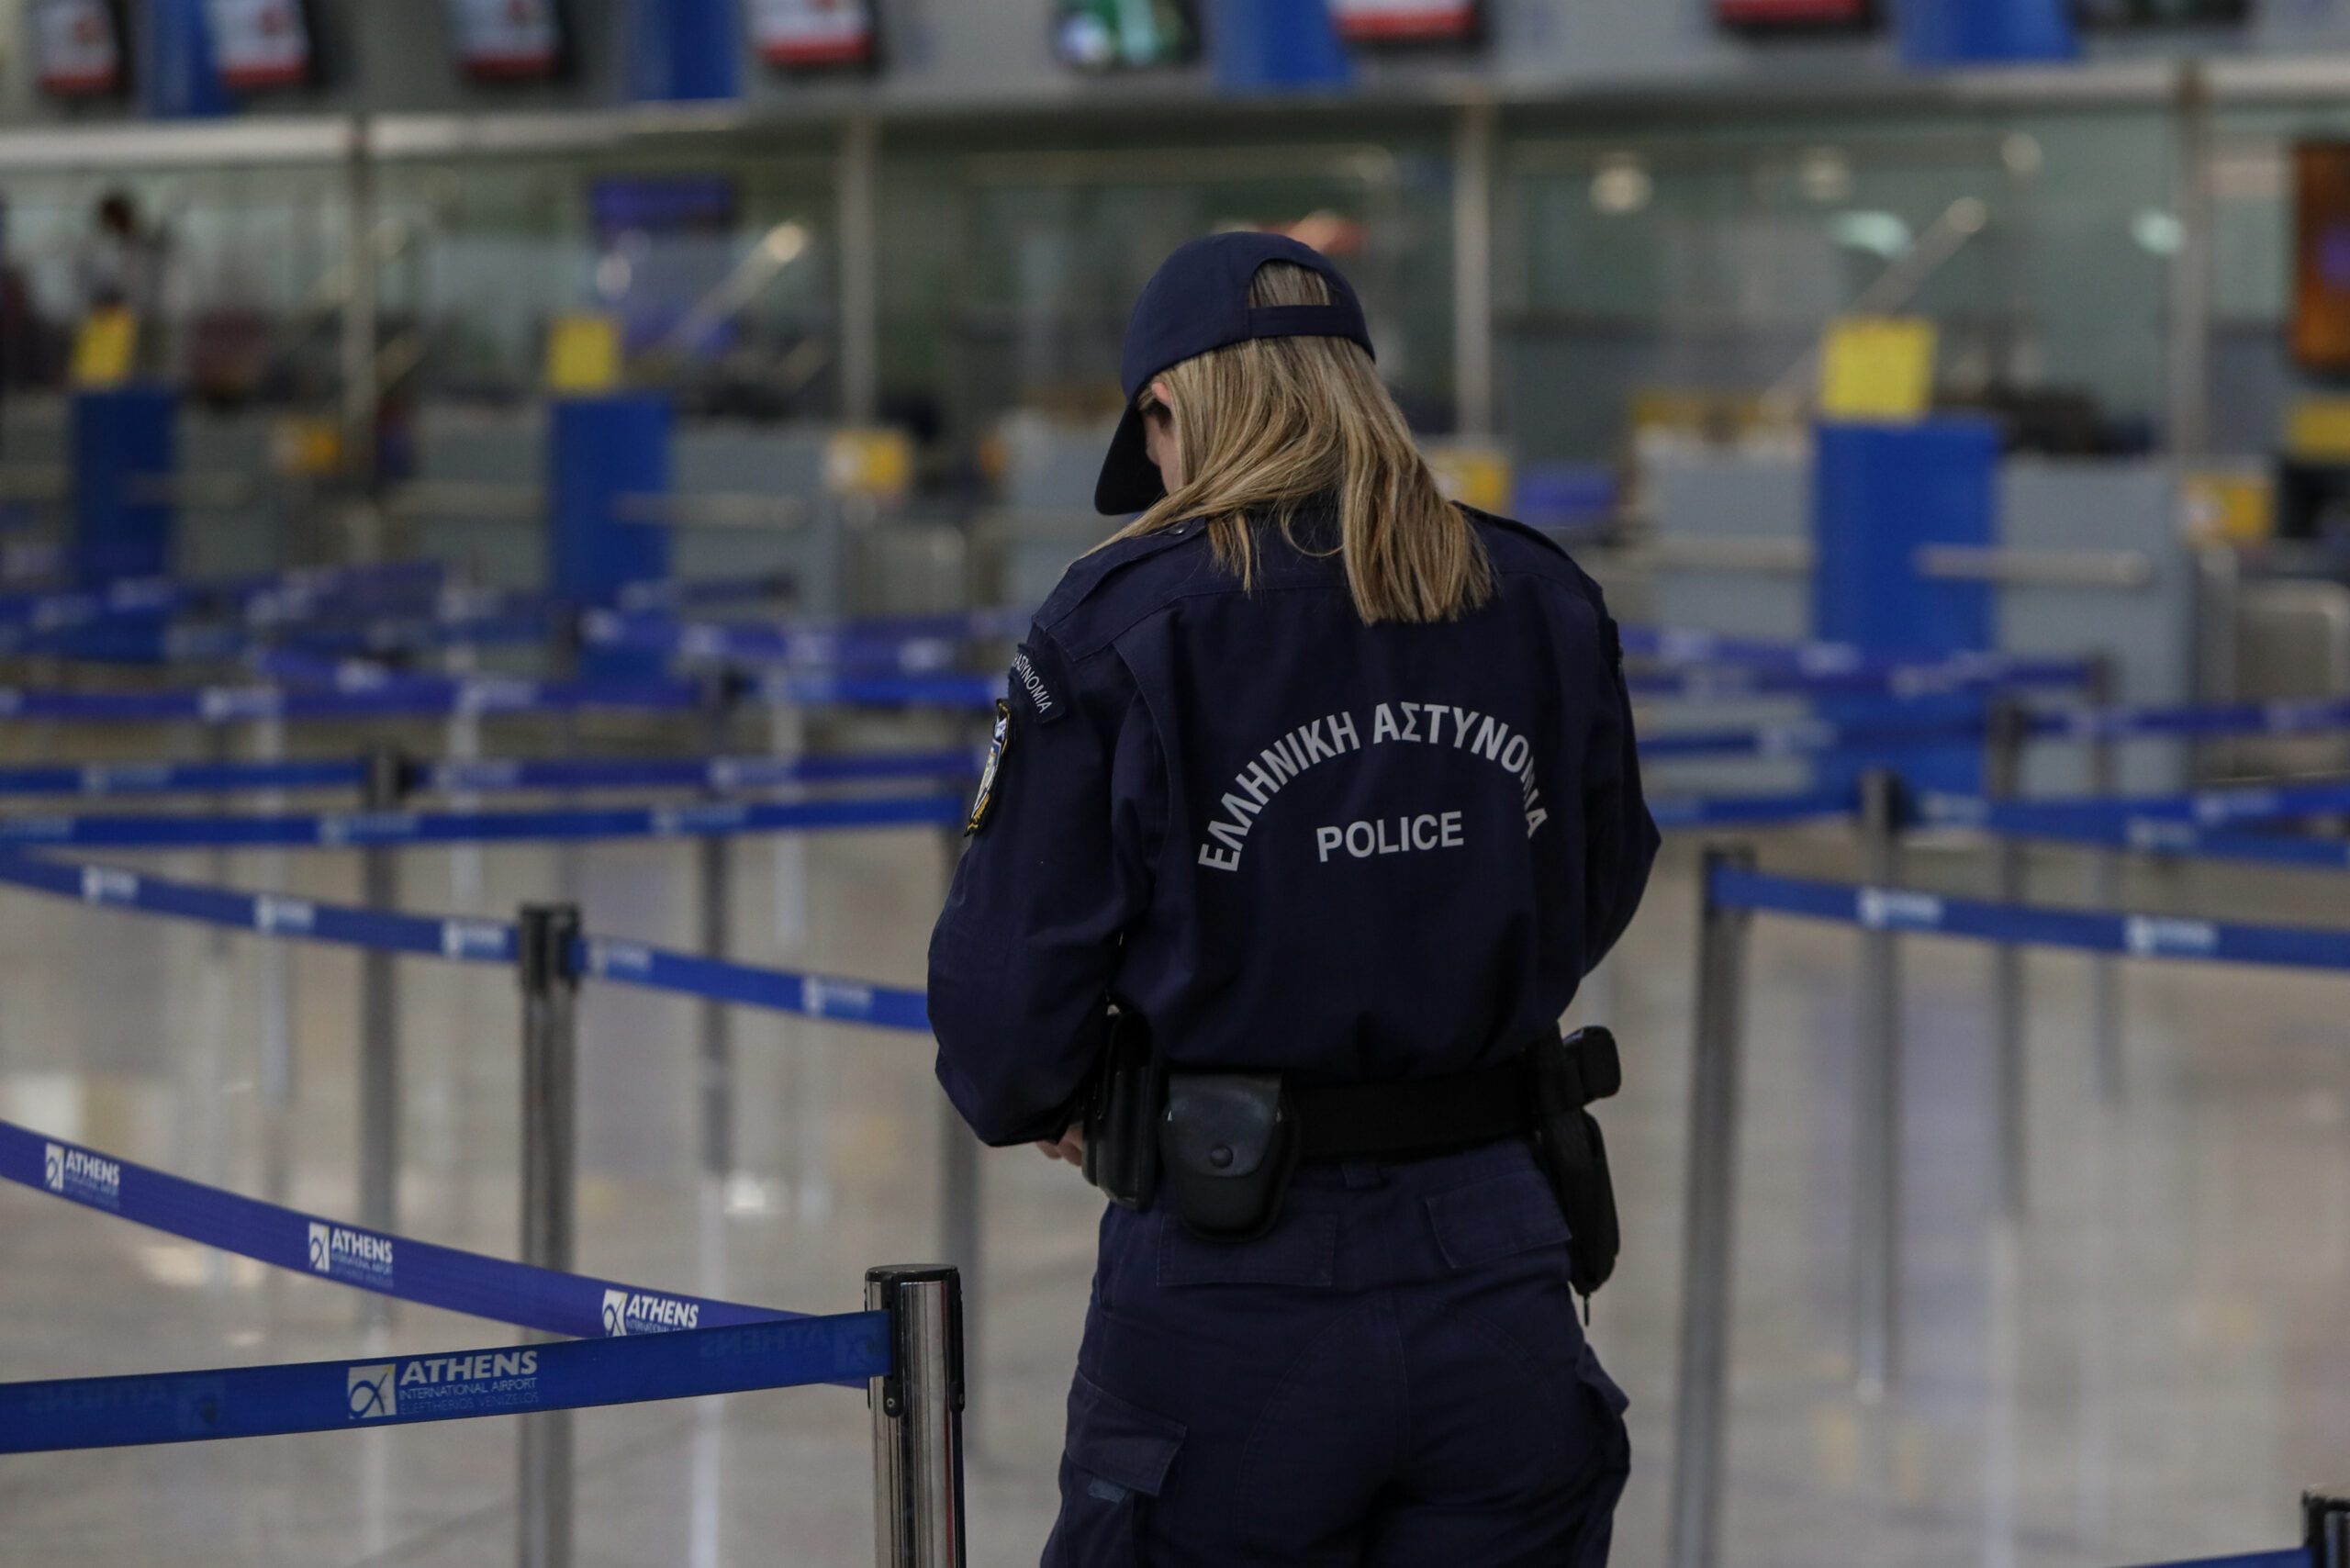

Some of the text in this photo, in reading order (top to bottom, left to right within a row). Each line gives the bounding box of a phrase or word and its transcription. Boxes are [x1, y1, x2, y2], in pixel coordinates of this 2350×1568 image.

[1197, 711, 1361, 872] ΕΛΛΗΝΙΚΗ
[1316, 811, 1465, 863] POLICE
[65, 1148, 120, 1187] ATHENS
[330, 1227, 394, 1264] ATHENS
[626, 1294, 699, 1329] ATHENS
[399, 1350, 538, 1385] ATHENS
[398, 1377, 537, 1401] INTERNATIONAL AIRPORT
